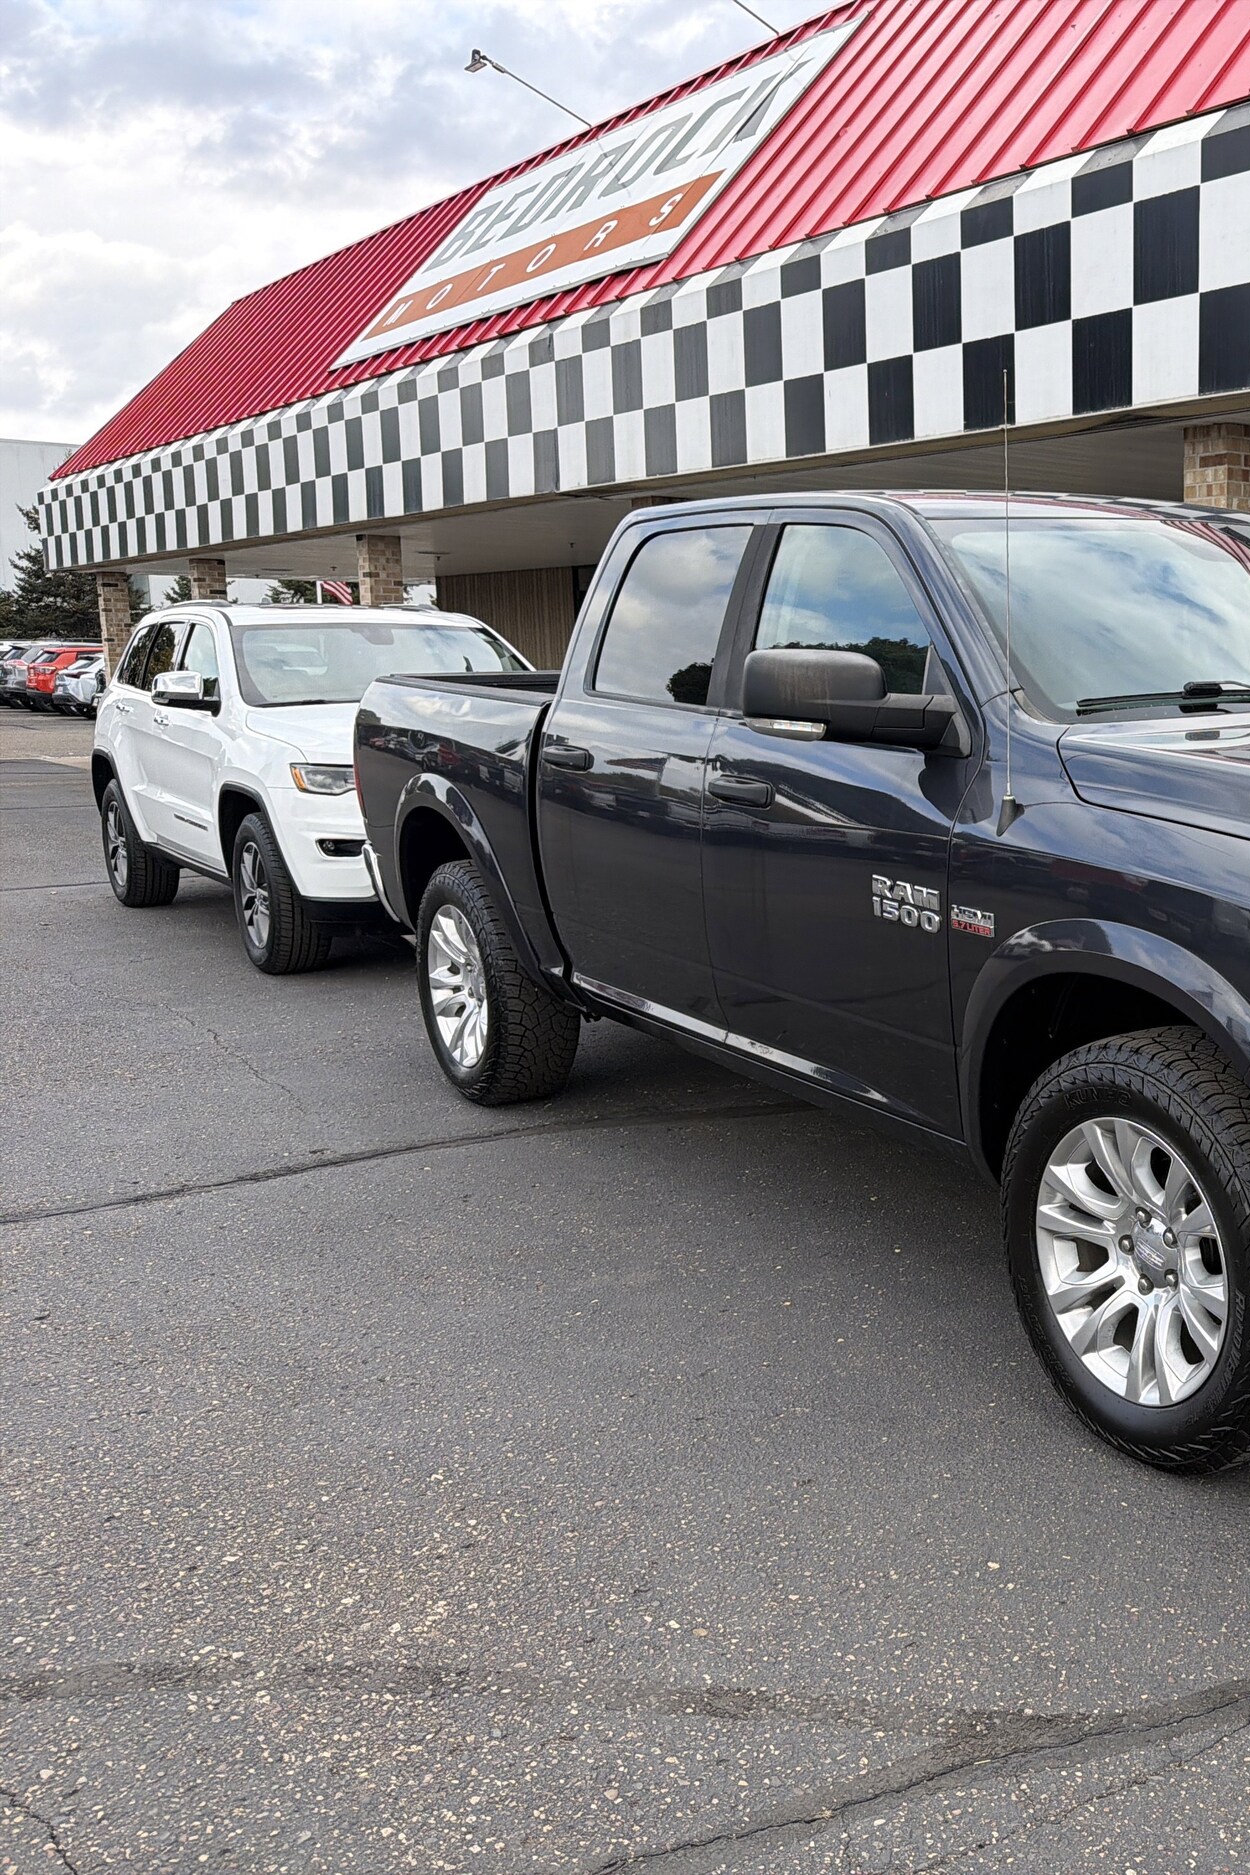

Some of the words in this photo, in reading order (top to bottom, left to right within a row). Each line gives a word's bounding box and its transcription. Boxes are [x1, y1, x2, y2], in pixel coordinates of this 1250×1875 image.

[422, 60, 812, 273] BEDROCK
[383, 194, 683, 327] MOTORS
[872, 874, 940, 911] RAM
[872, 896, 942, 934] 1500
[966, 922, 992, 935] LITER
